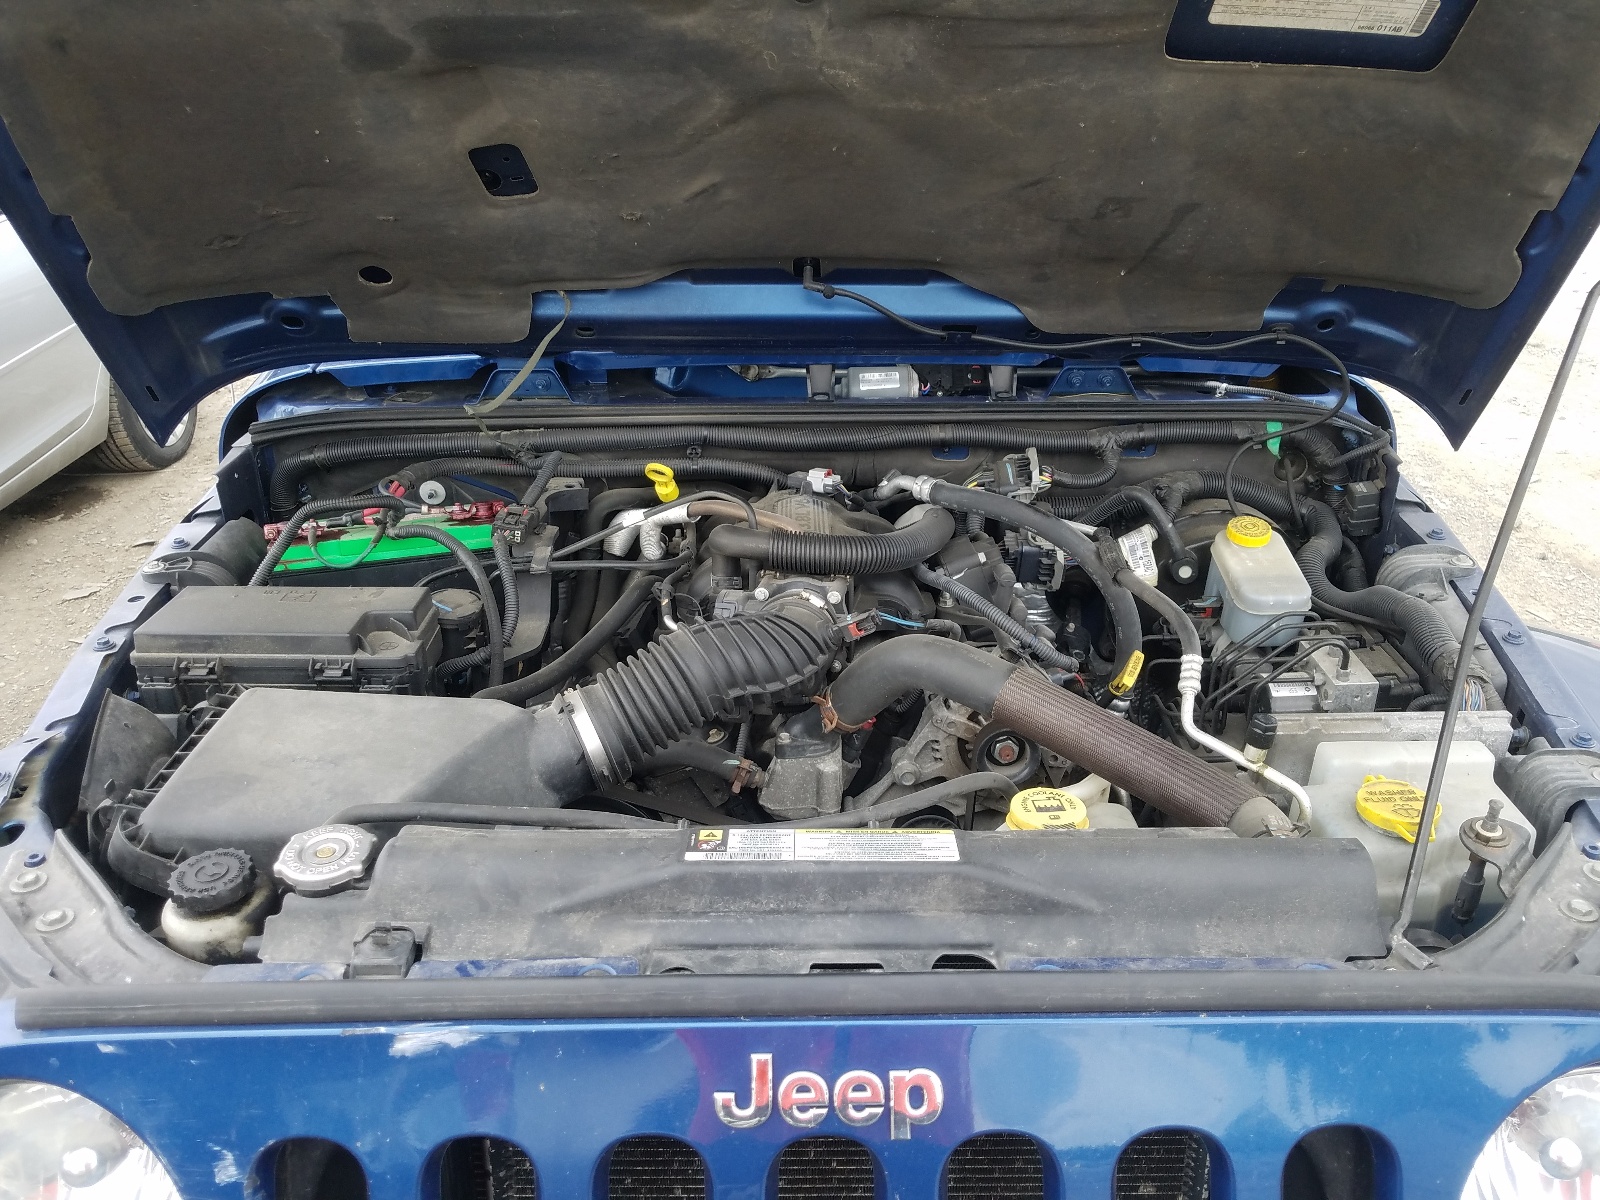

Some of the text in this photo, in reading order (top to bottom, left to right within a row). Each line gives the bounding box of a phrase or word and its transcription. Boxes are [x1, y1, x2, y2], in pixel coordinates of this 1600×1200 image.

[1365, 788, 1417, 796] WASHER
[307, 863, 339, 874] OPEN
[713, 1052, 944, 1141] Jeep
